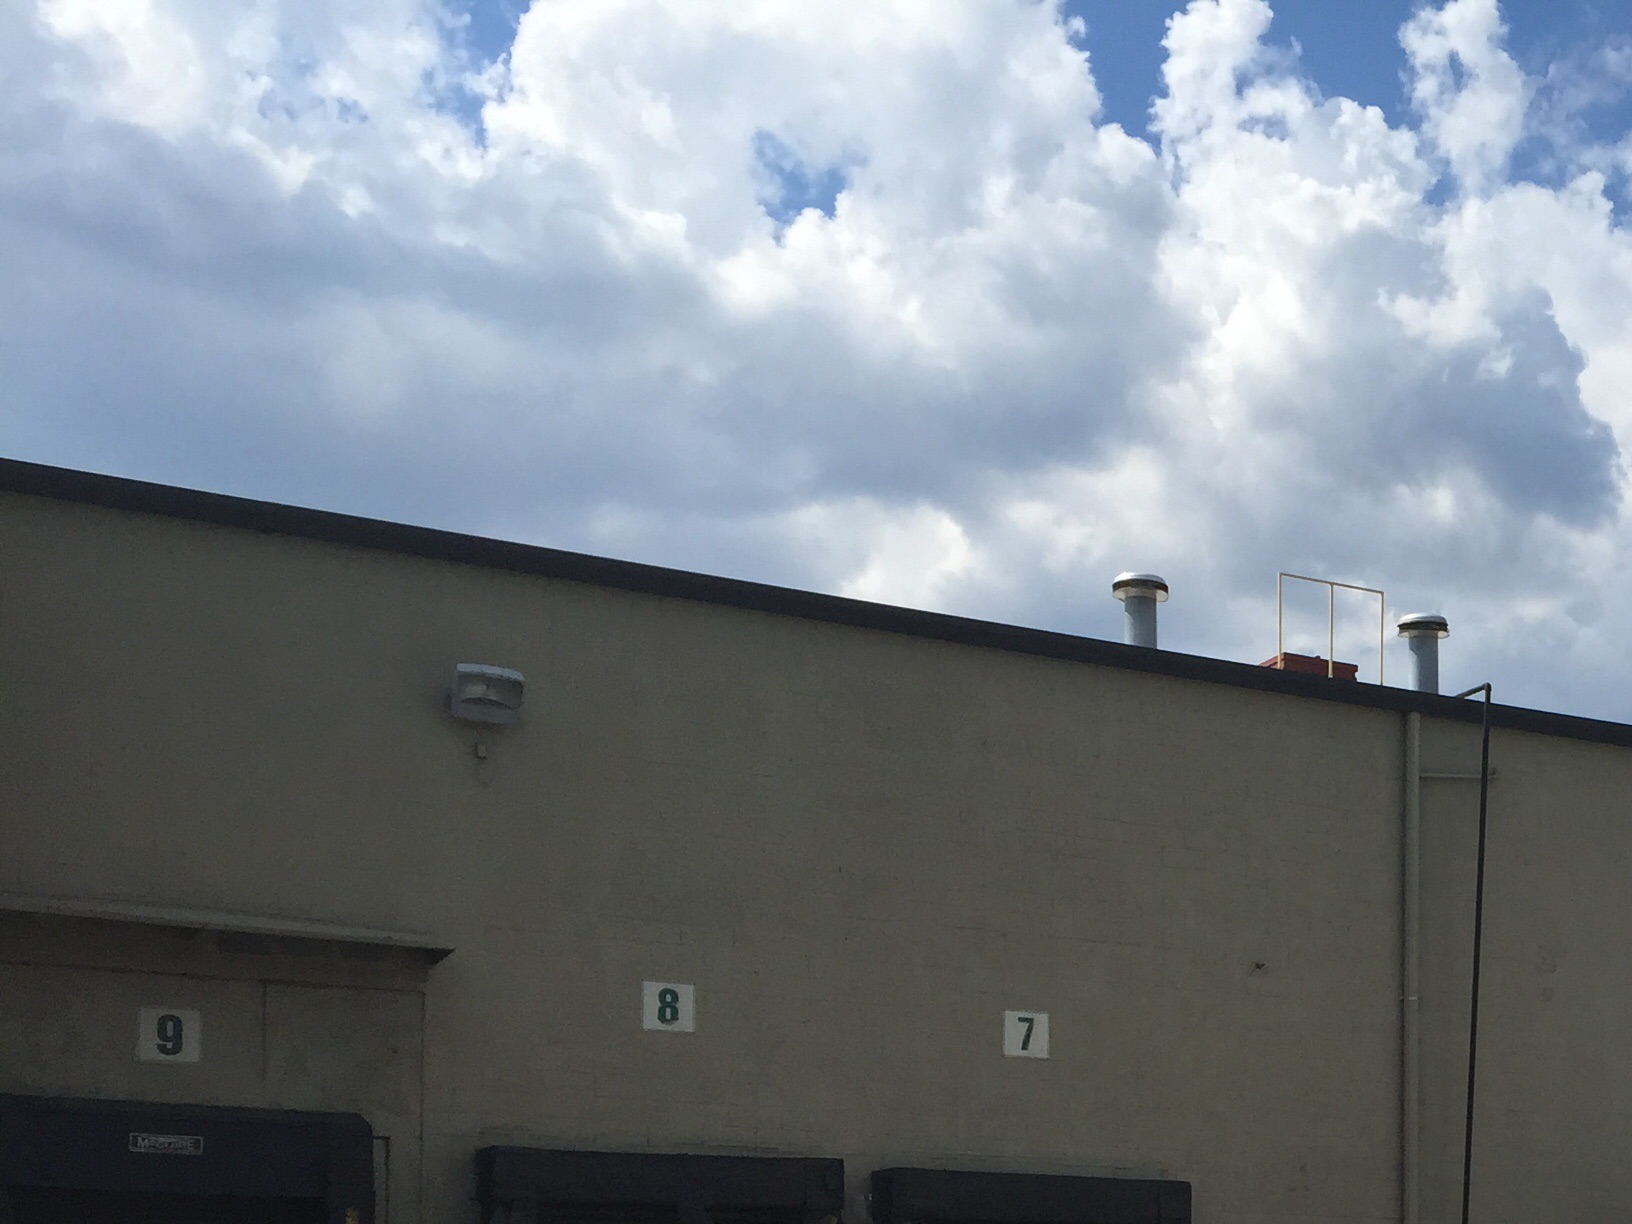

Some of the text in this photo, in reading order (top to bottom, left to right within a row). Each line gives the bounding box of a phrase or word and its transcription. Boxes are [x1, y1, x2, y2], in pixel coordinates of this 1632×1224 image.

[657, 987, 680, 1026] 8
[156, 1014, 184, 1056] 9
[1017, 1016, 1035, 1051] 7
